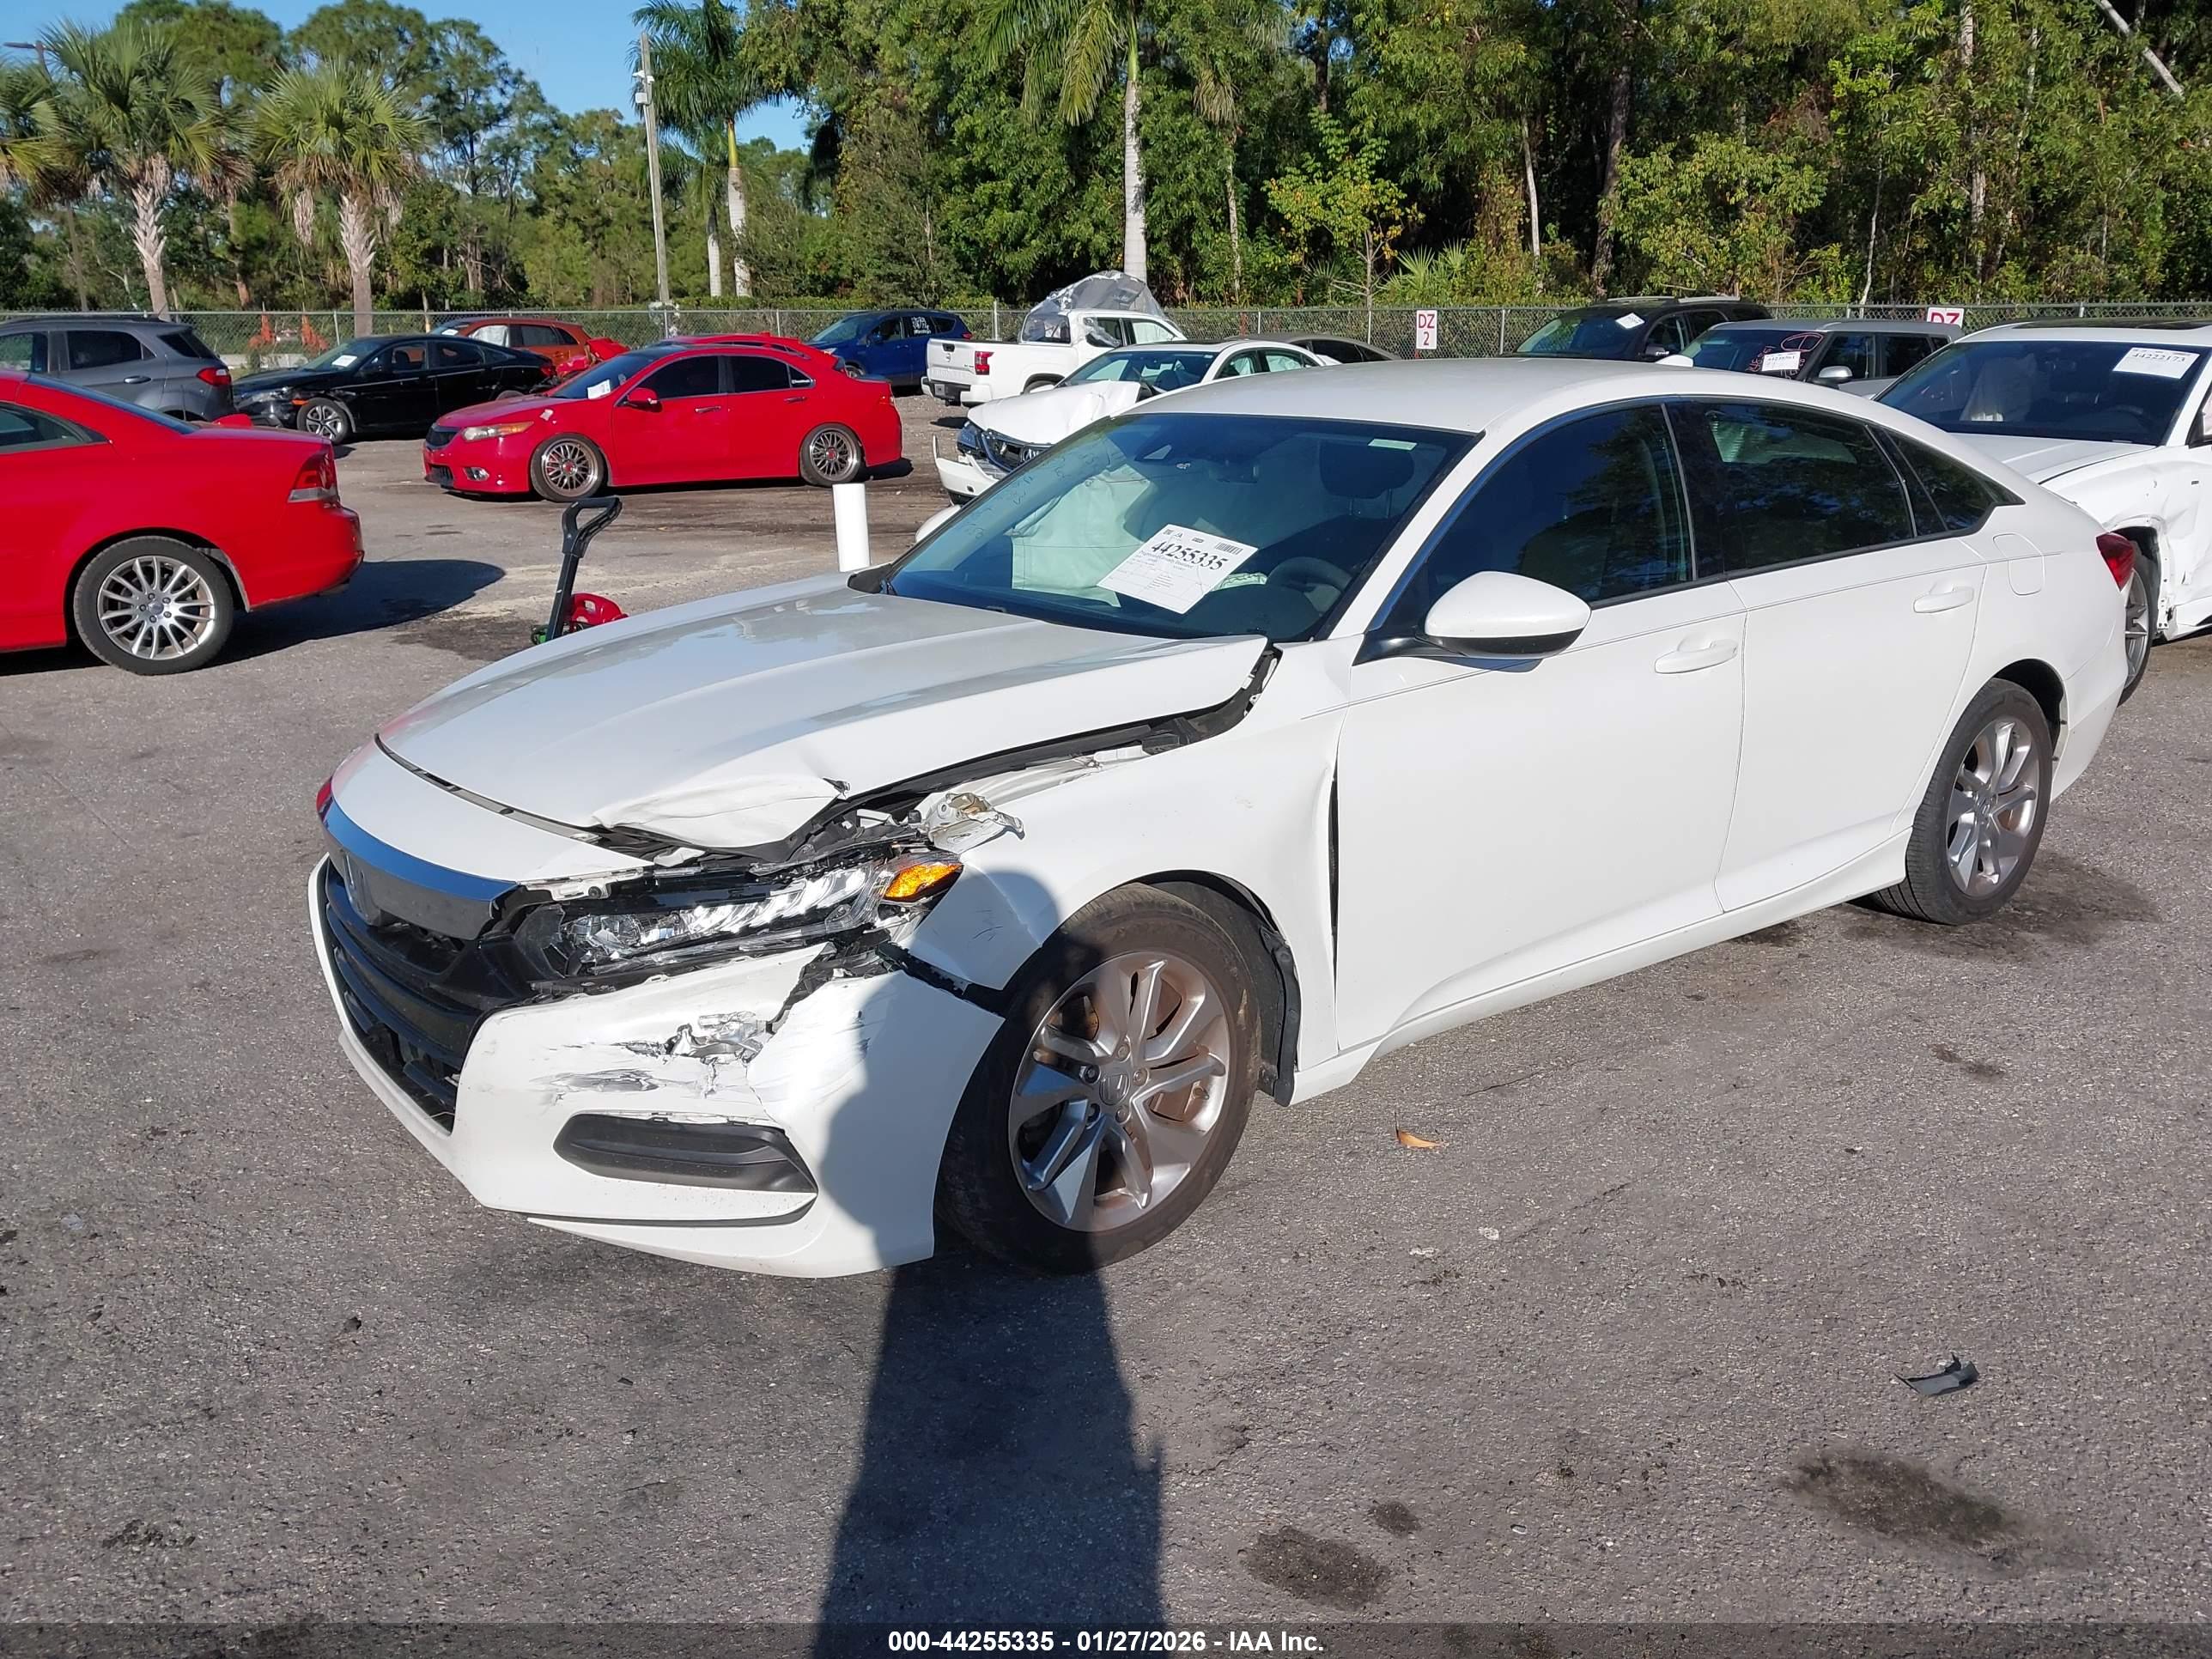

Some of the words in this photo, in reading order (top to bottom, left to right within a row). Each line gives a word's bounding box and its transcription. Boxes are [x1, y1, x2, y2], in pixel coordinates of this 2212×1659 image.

[1418, 313, 1435, 329] DZ
[1423, 331, 1430, 346] 2
[1152, 541, 1228, 570] 44255335
